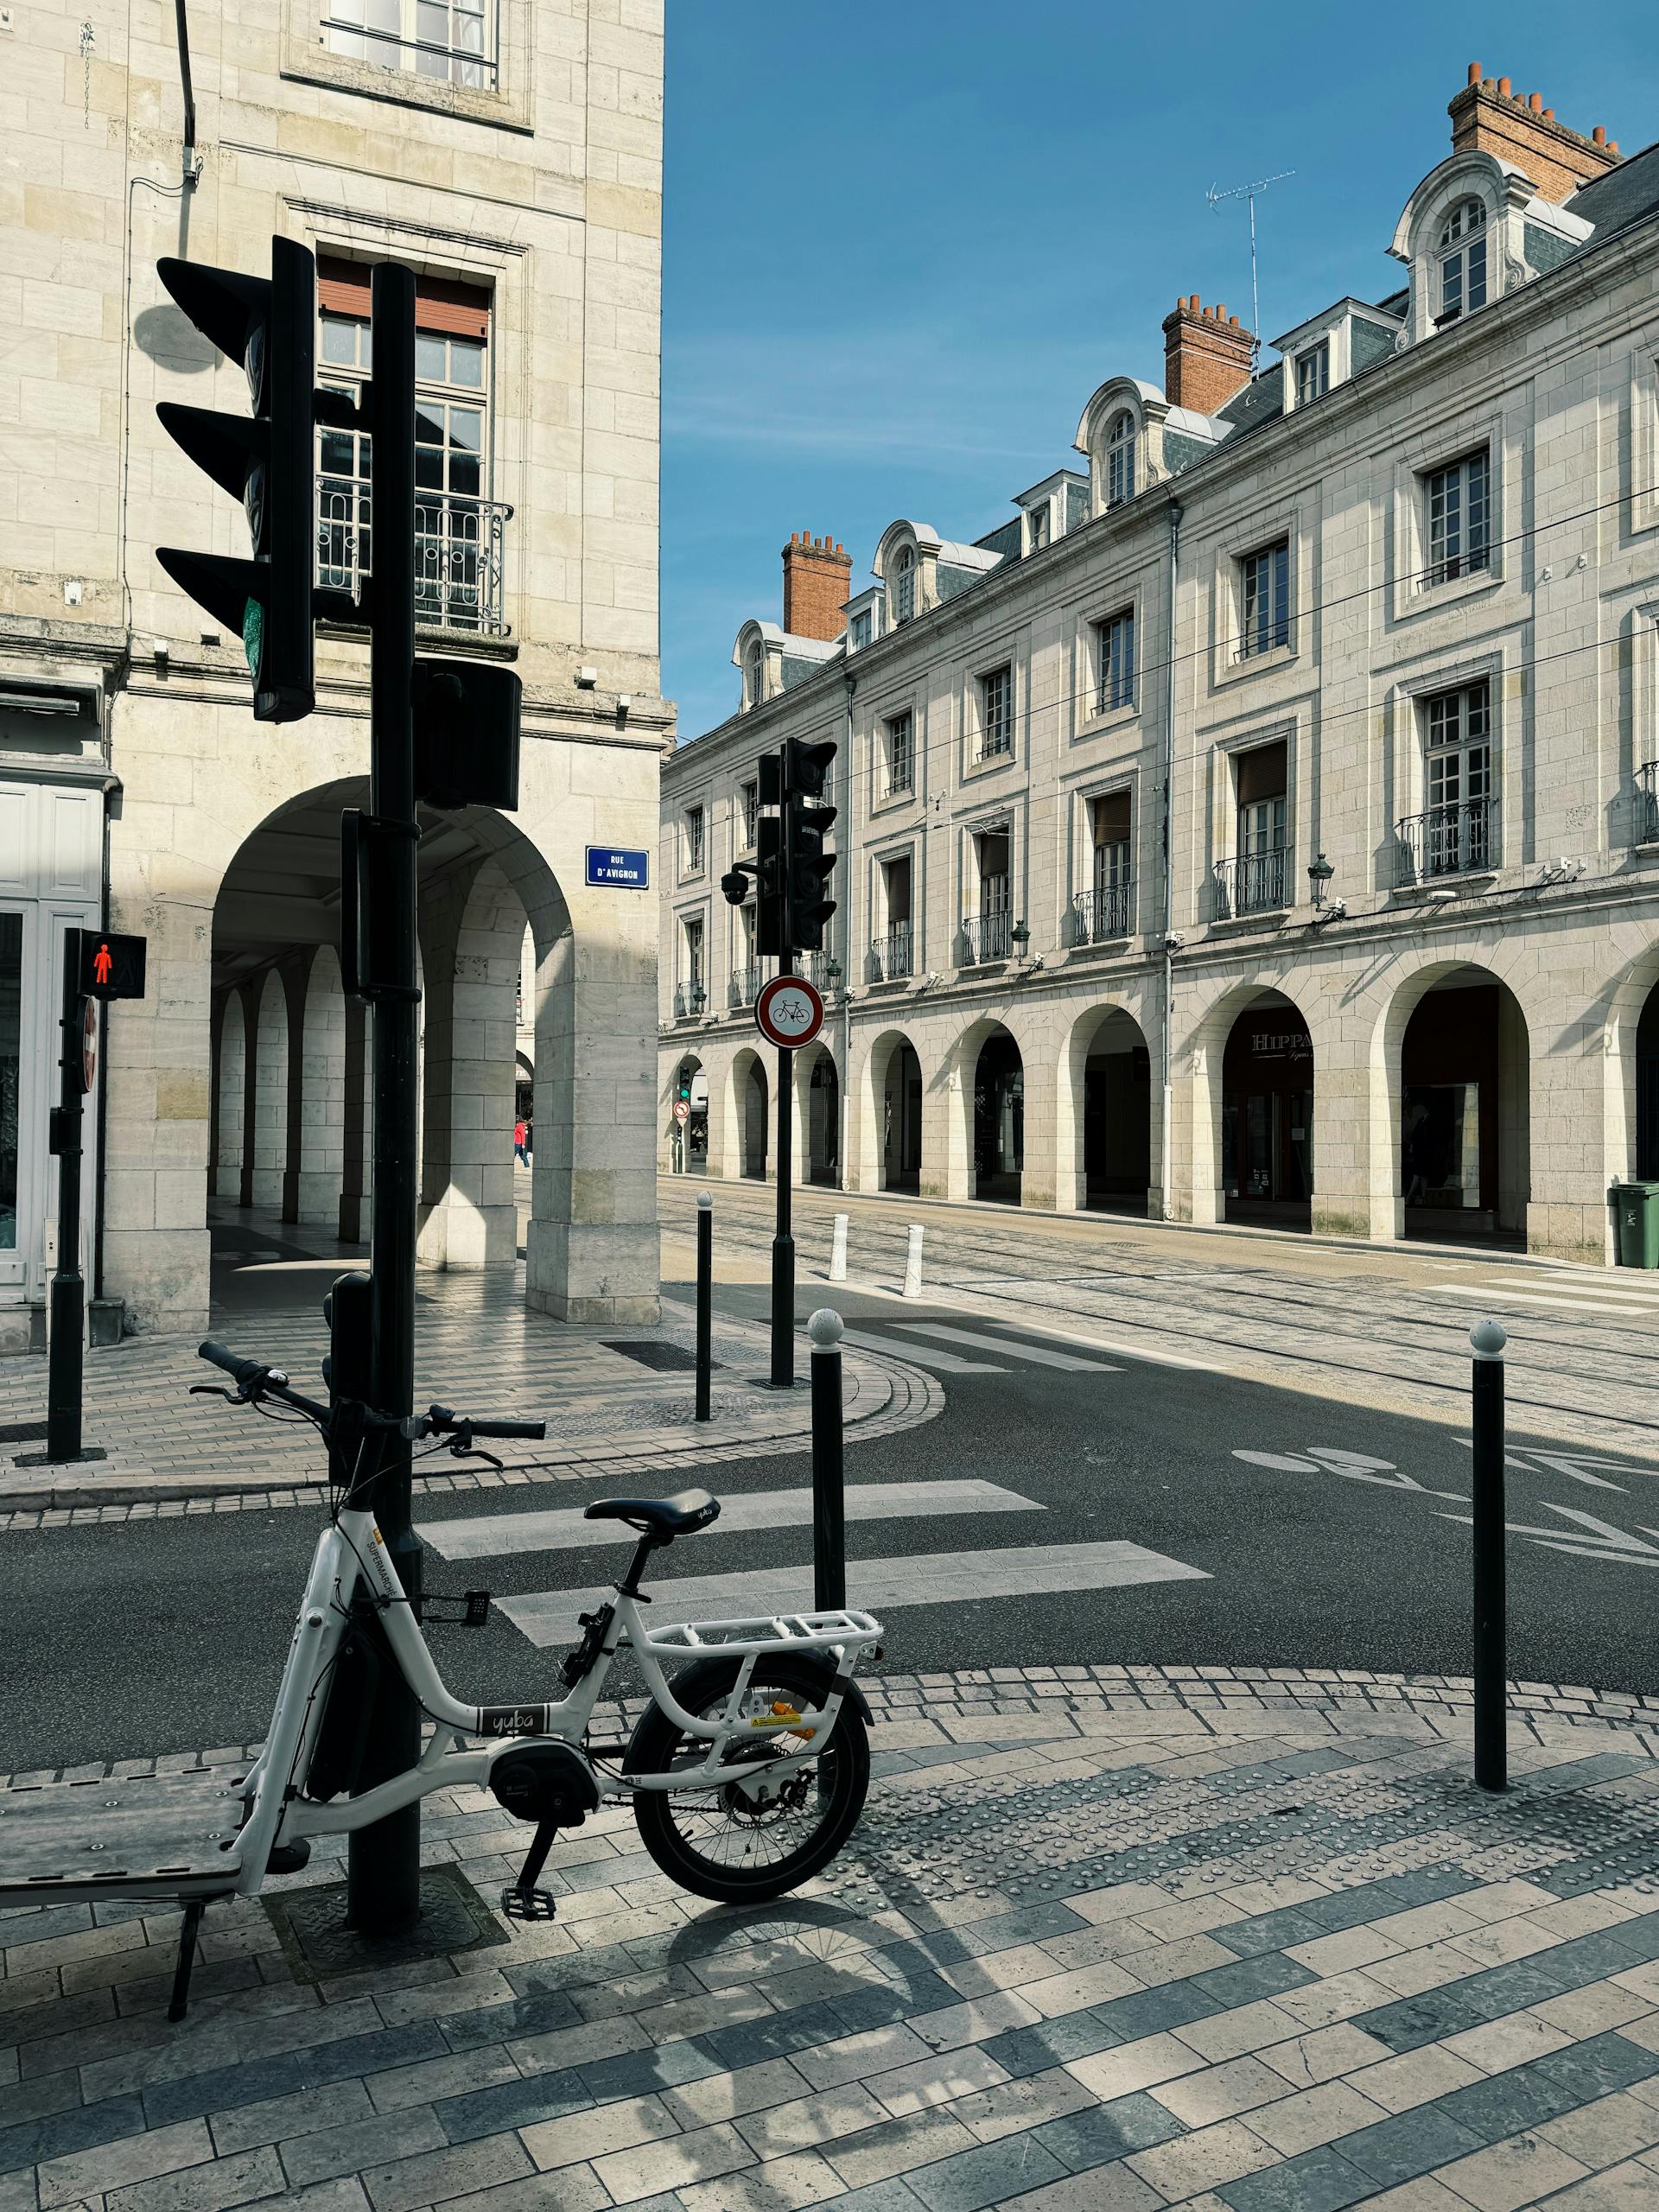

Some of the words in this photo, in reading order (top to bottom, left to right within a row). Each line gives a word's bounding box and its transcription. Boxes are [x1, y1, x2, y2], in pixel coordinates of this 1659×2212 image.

[611, 855, 624, 864] RUE
[597, 868, 638, 880] D'AVIGNON
[366, 1541, 397, 1599] SUPERMARCHÉ
[493, 1709, 534, 1735] yuba
